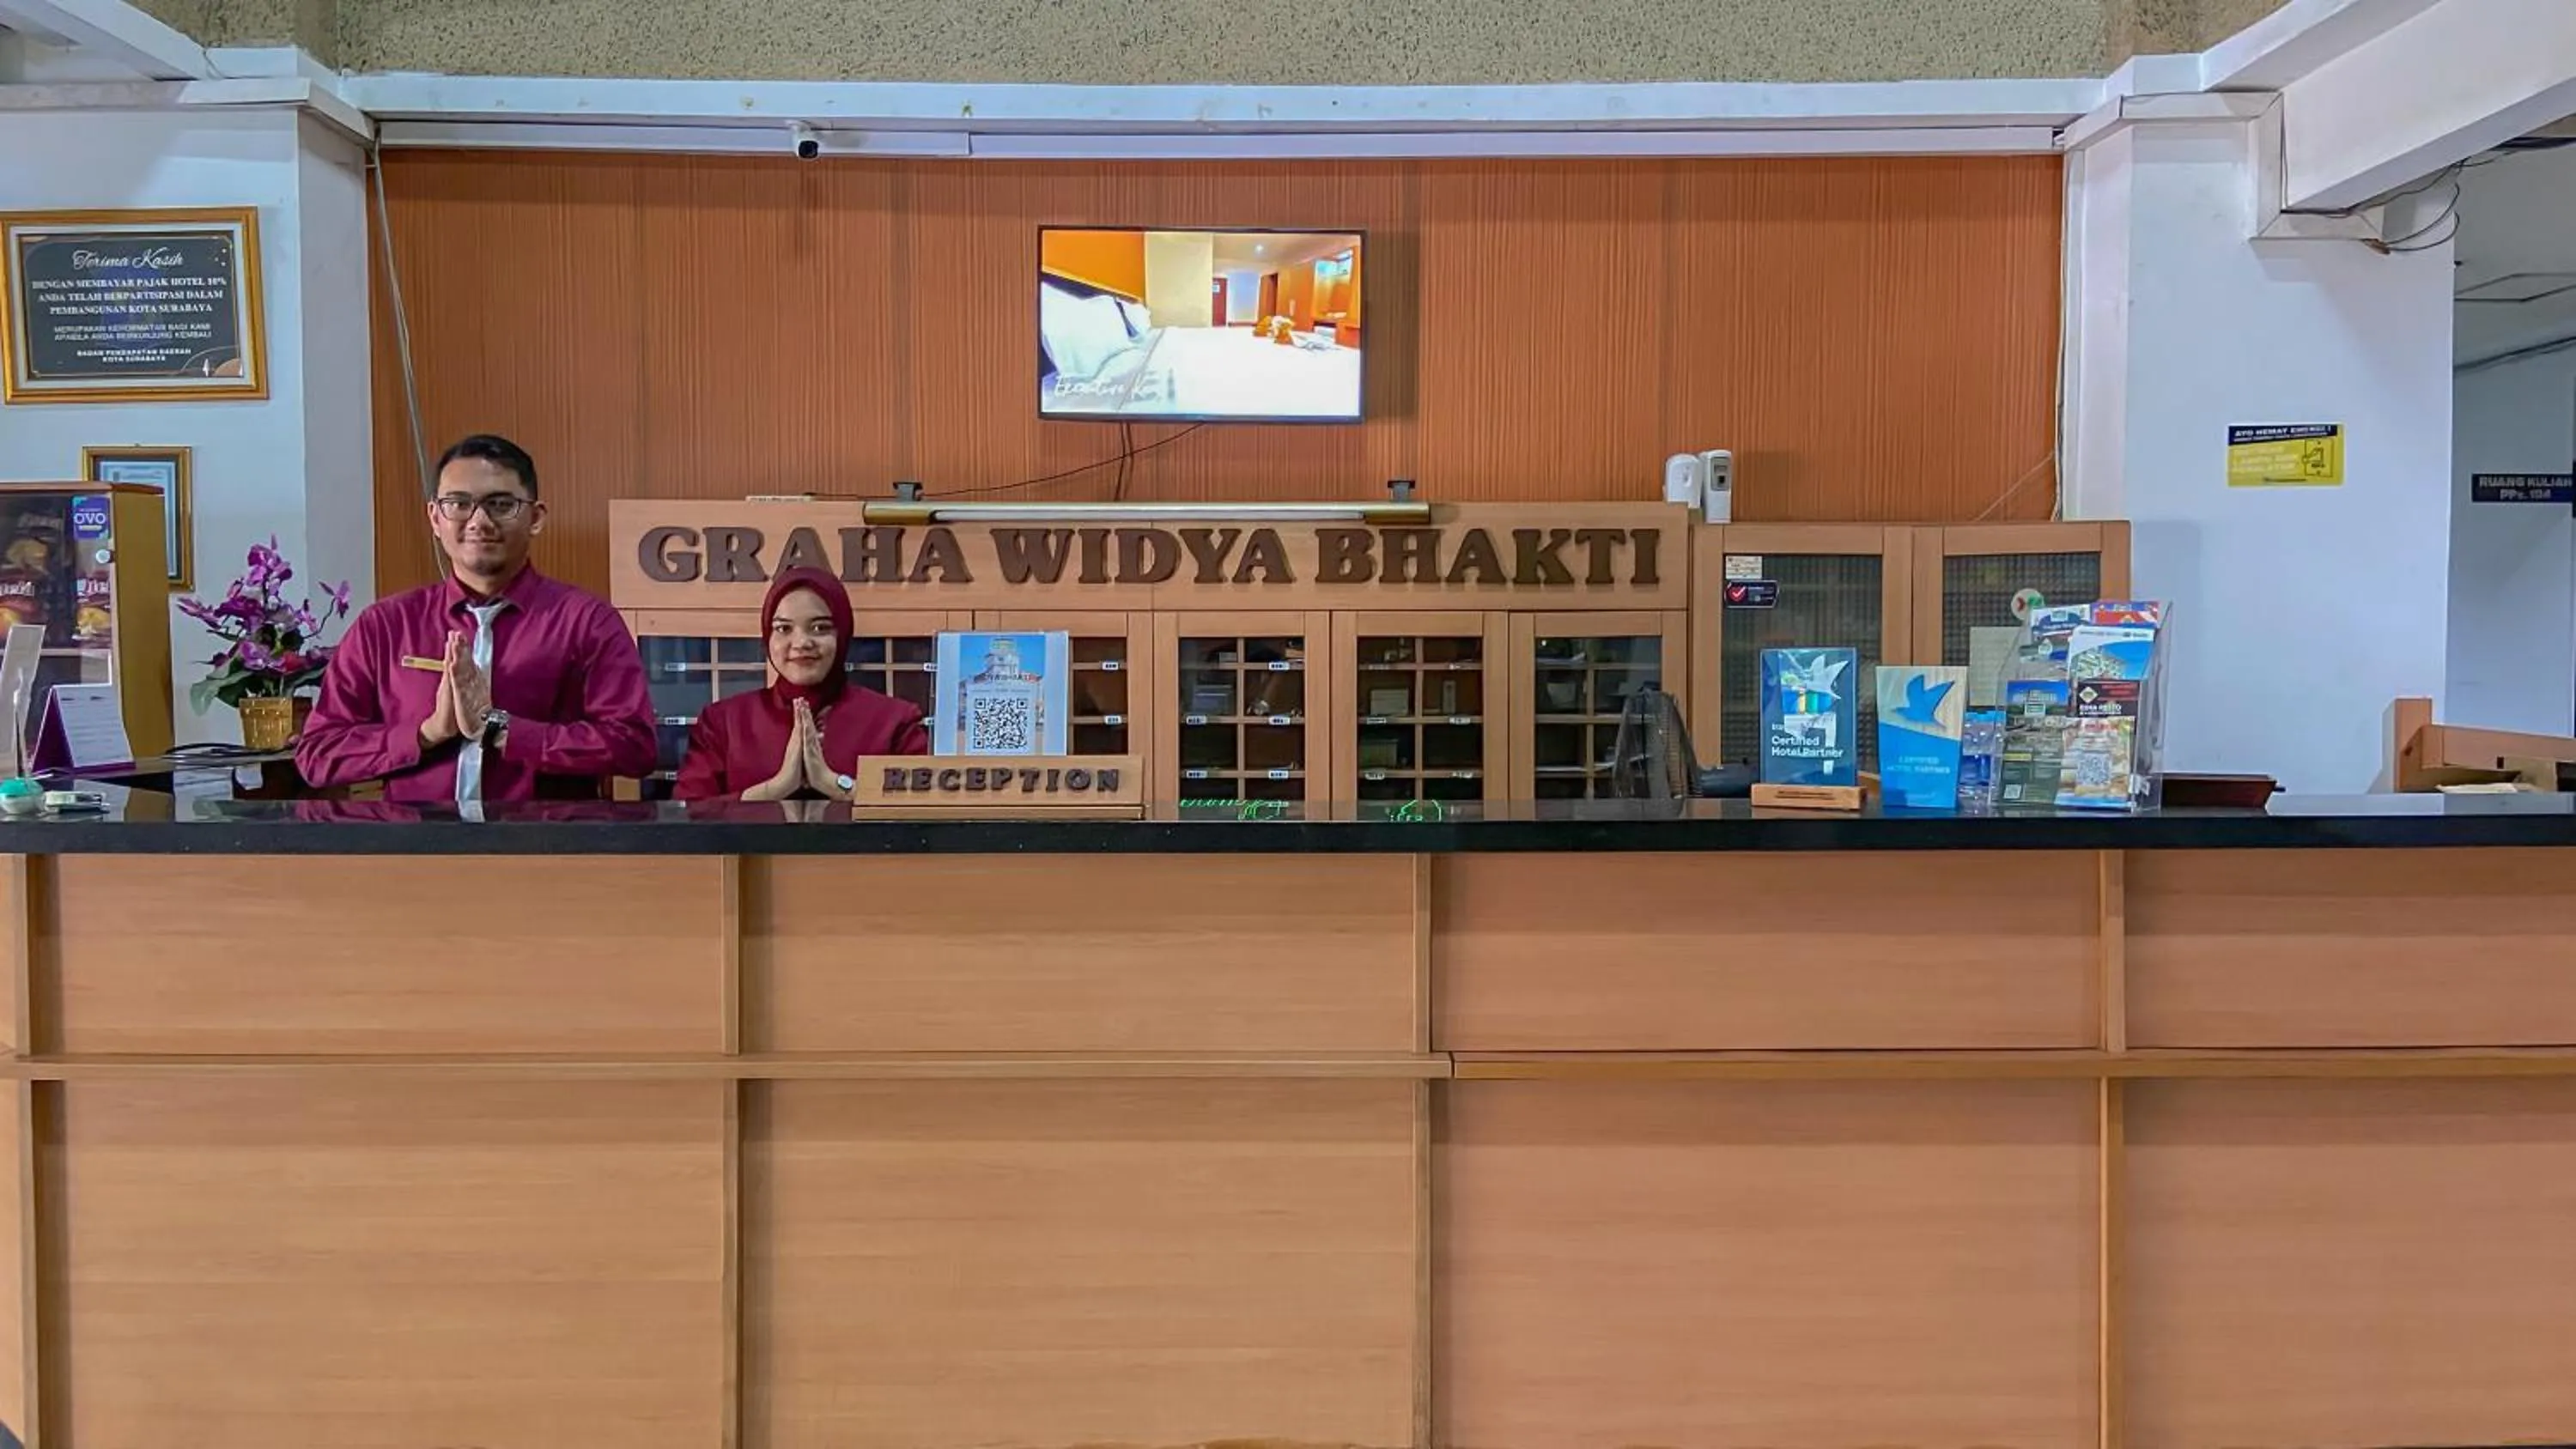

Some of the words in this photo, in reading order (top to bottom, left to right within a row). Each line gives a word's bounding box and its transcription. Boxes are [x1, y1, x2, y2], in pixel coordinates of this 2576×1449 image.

[71, 250, 130, 270] Terima
[131, 246, 184, 269] Kasih
[32, 280, 75, 289] DENGAN
[76, 278, 135, 288] MEMBAYAR
[137, 277, 169, 288] PAJAK
[37, 293, 66, 302] ANDA
[103, 291, 185, 300] BERPARTISIPASI
[186, 290, 223, 300] DALAM
[50, 305, 128, 315] PEMBANGUNAN
[159, 303, 213, 312] SURABAYA
[2479, 476, 2524, 487] RUANG
[74, 512, 106, 524] OVO
[638, 525, 974, 583] GRAHA
[989, 527, 1295, 585] WIDYA
[1314, 528, 1661, 585] BHAKTI
[1771, 736, 1820, 746] Certified
[1771, 746, 1802, 756] Hotel
[1803, 748, 1844, 758] Partner
[883, 767, 1120, 792] RECEPTION
